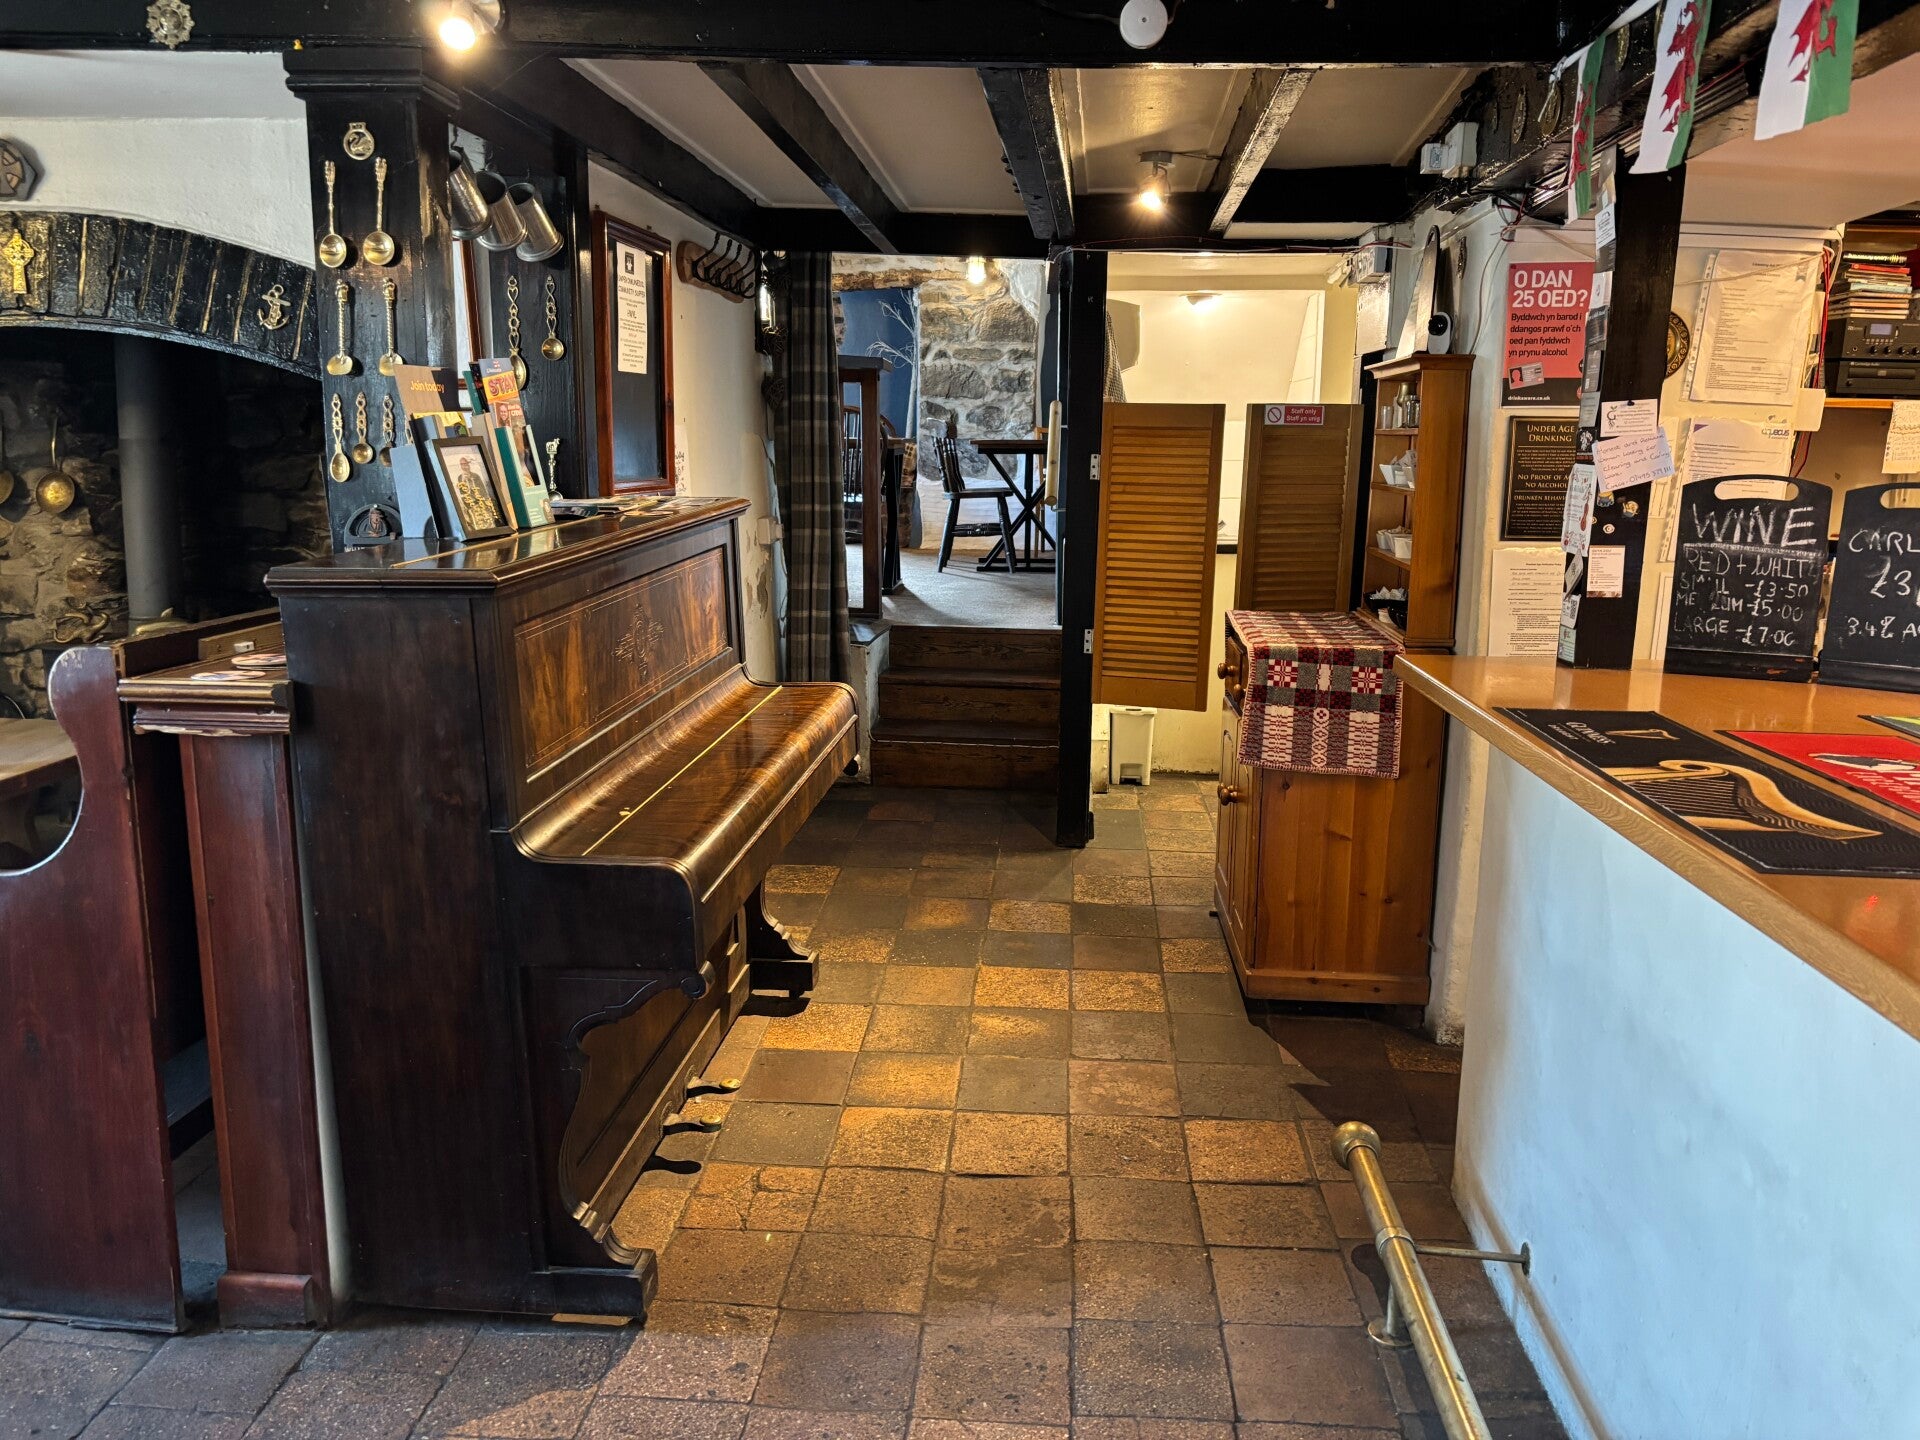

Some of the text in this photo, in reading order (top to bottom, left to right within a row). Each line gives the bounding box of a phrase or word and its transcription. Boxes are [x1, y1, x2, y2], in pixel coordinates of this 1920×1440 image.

[1515, 270, 1572, 288] O DAN
[1512, 290, 1588, 307] 25 OED?
[1512, 313, 1545, 322] Byddwch
[1546, 314, 1555, 322] yn
[1510, 326, 1541, 334] ddangos
[1543, 325, 1564, 334] prawf
[1524, 338, 1538, 346] pan
[1540, 337, 1570, 346] fyddwch
[410, 381, 444, 393] Join today
[1529, 434, 1572, 442] DRINKING
[1692, 502, 1817, 547] WINE
[1684, 547, 1730, 575] RED
[1679, 572, 1729, 594] SMLL
[1676, 591, 1743, 612] MEUM
